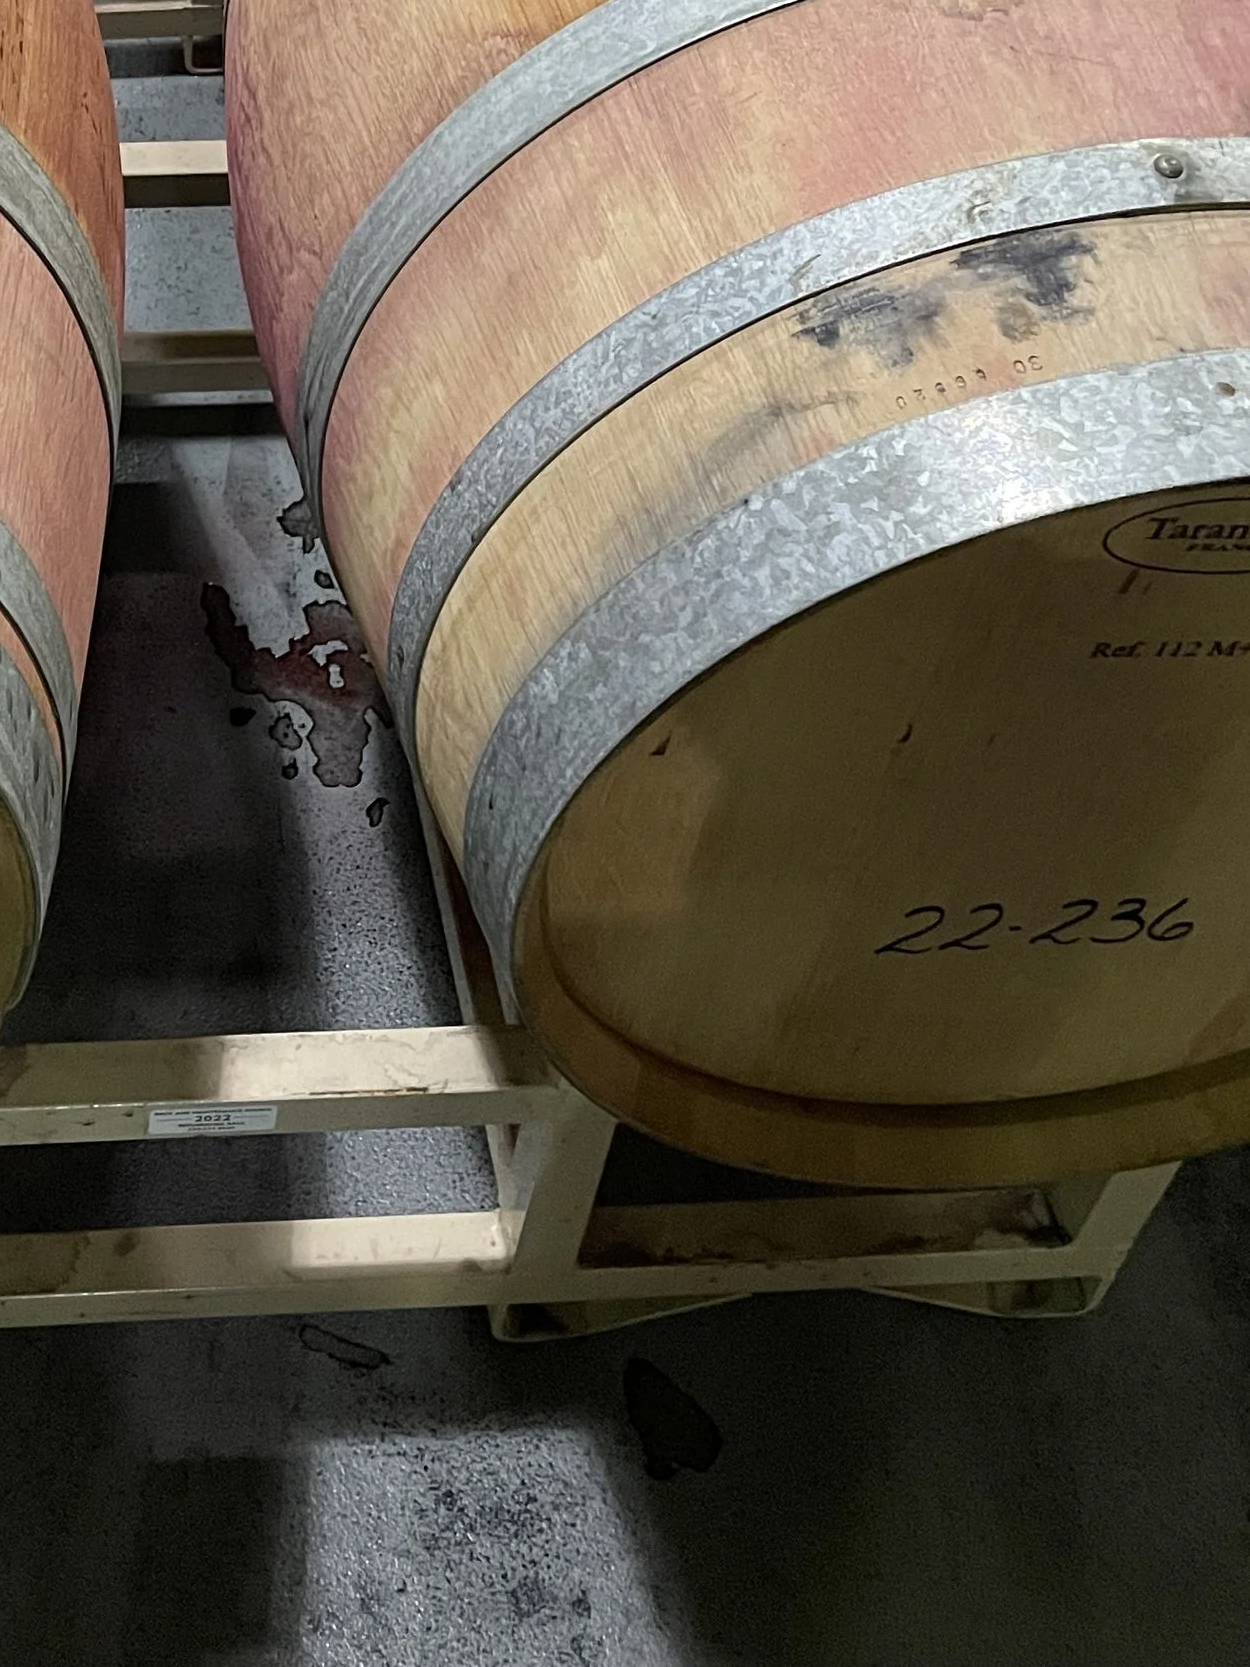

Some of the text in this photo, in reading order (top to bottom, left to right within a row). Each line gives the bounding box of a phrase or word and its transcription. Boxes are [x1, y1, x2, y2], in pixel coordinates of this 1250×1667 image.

[1155, 640, 1202, 657] 112
[873, 897, 1194, 954] 22-236
[194, 1114, 232, 1122] 2022
